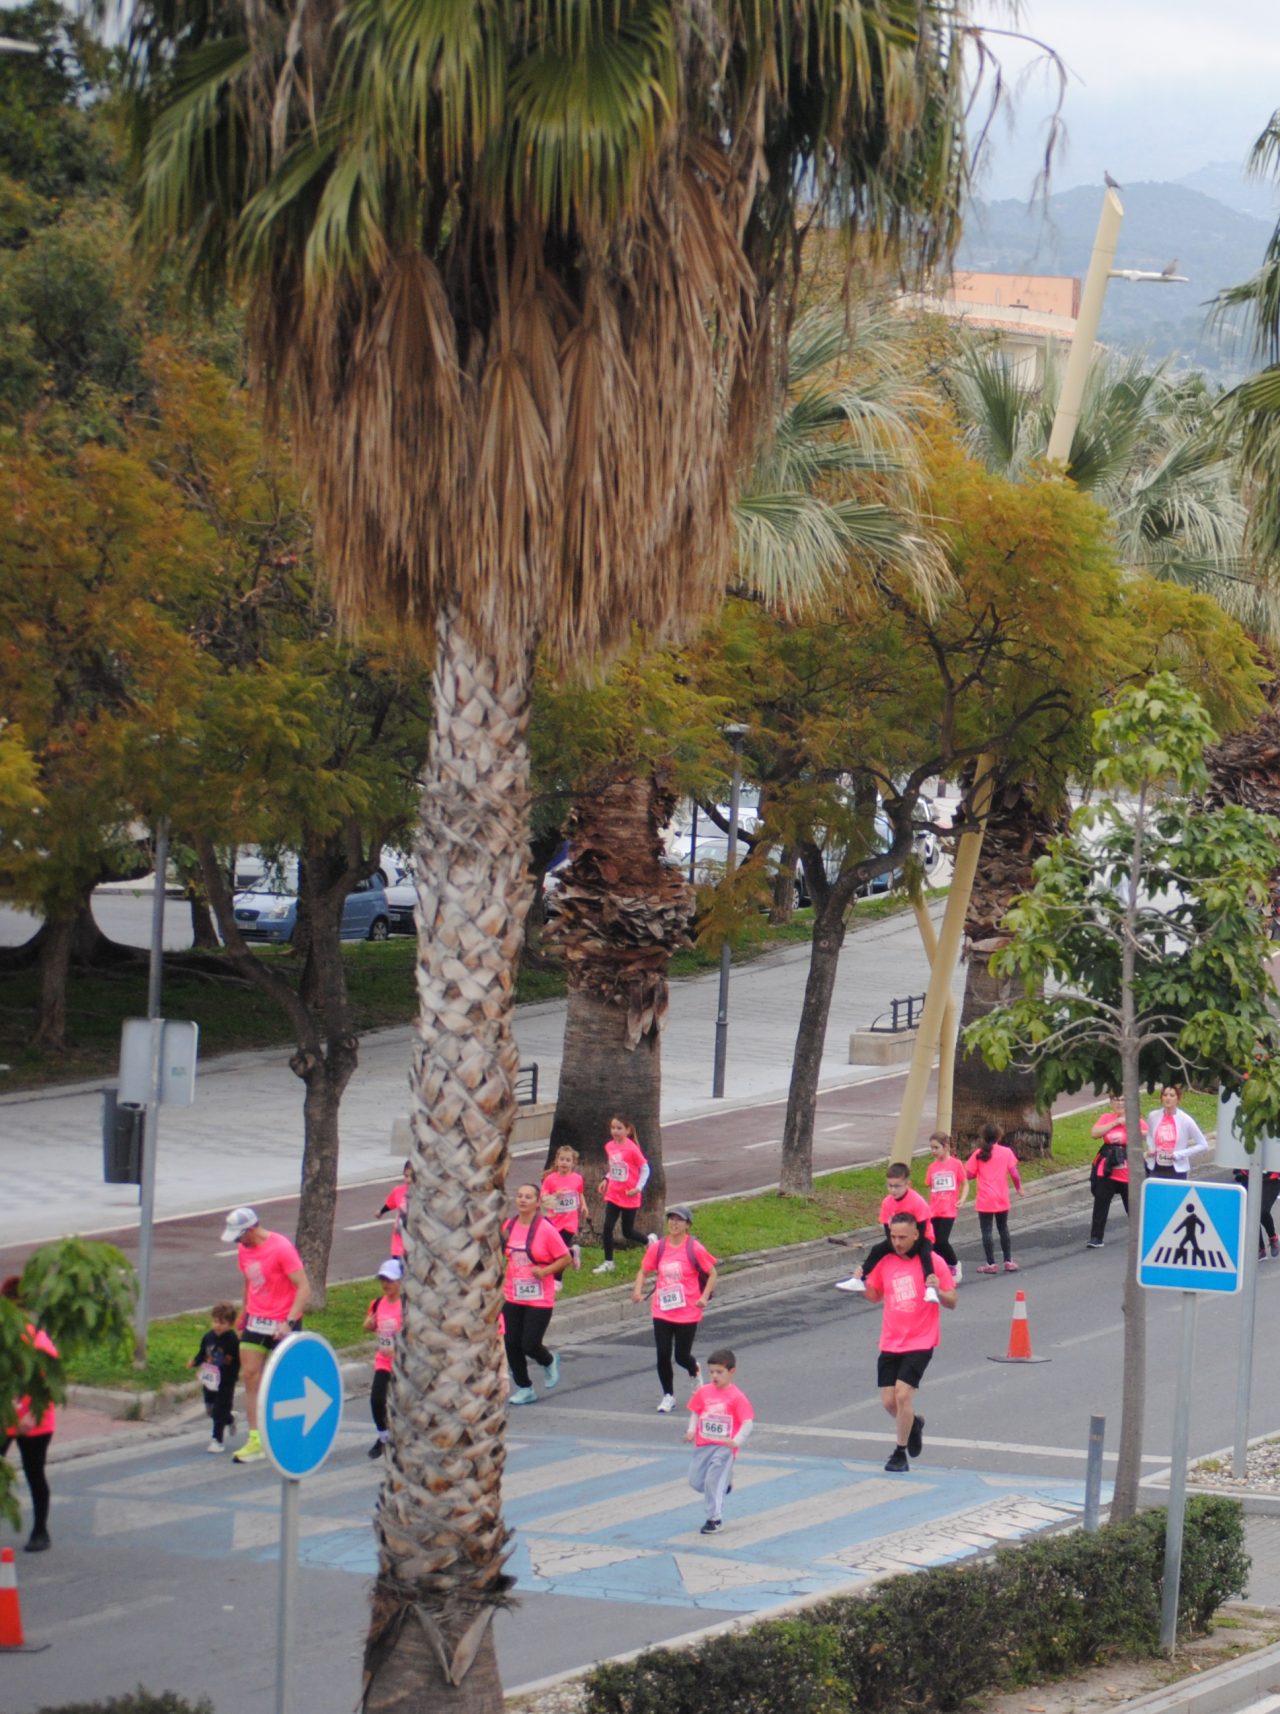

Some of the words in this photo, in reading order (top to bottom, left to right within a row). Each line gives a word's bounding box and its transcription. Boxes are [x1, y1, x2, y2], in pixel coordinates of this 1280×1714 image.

[559, 1199, 574, 1208] 420
[519, 1286, 535, 1294] 542
[705, 1422, 724, 1434] 666
